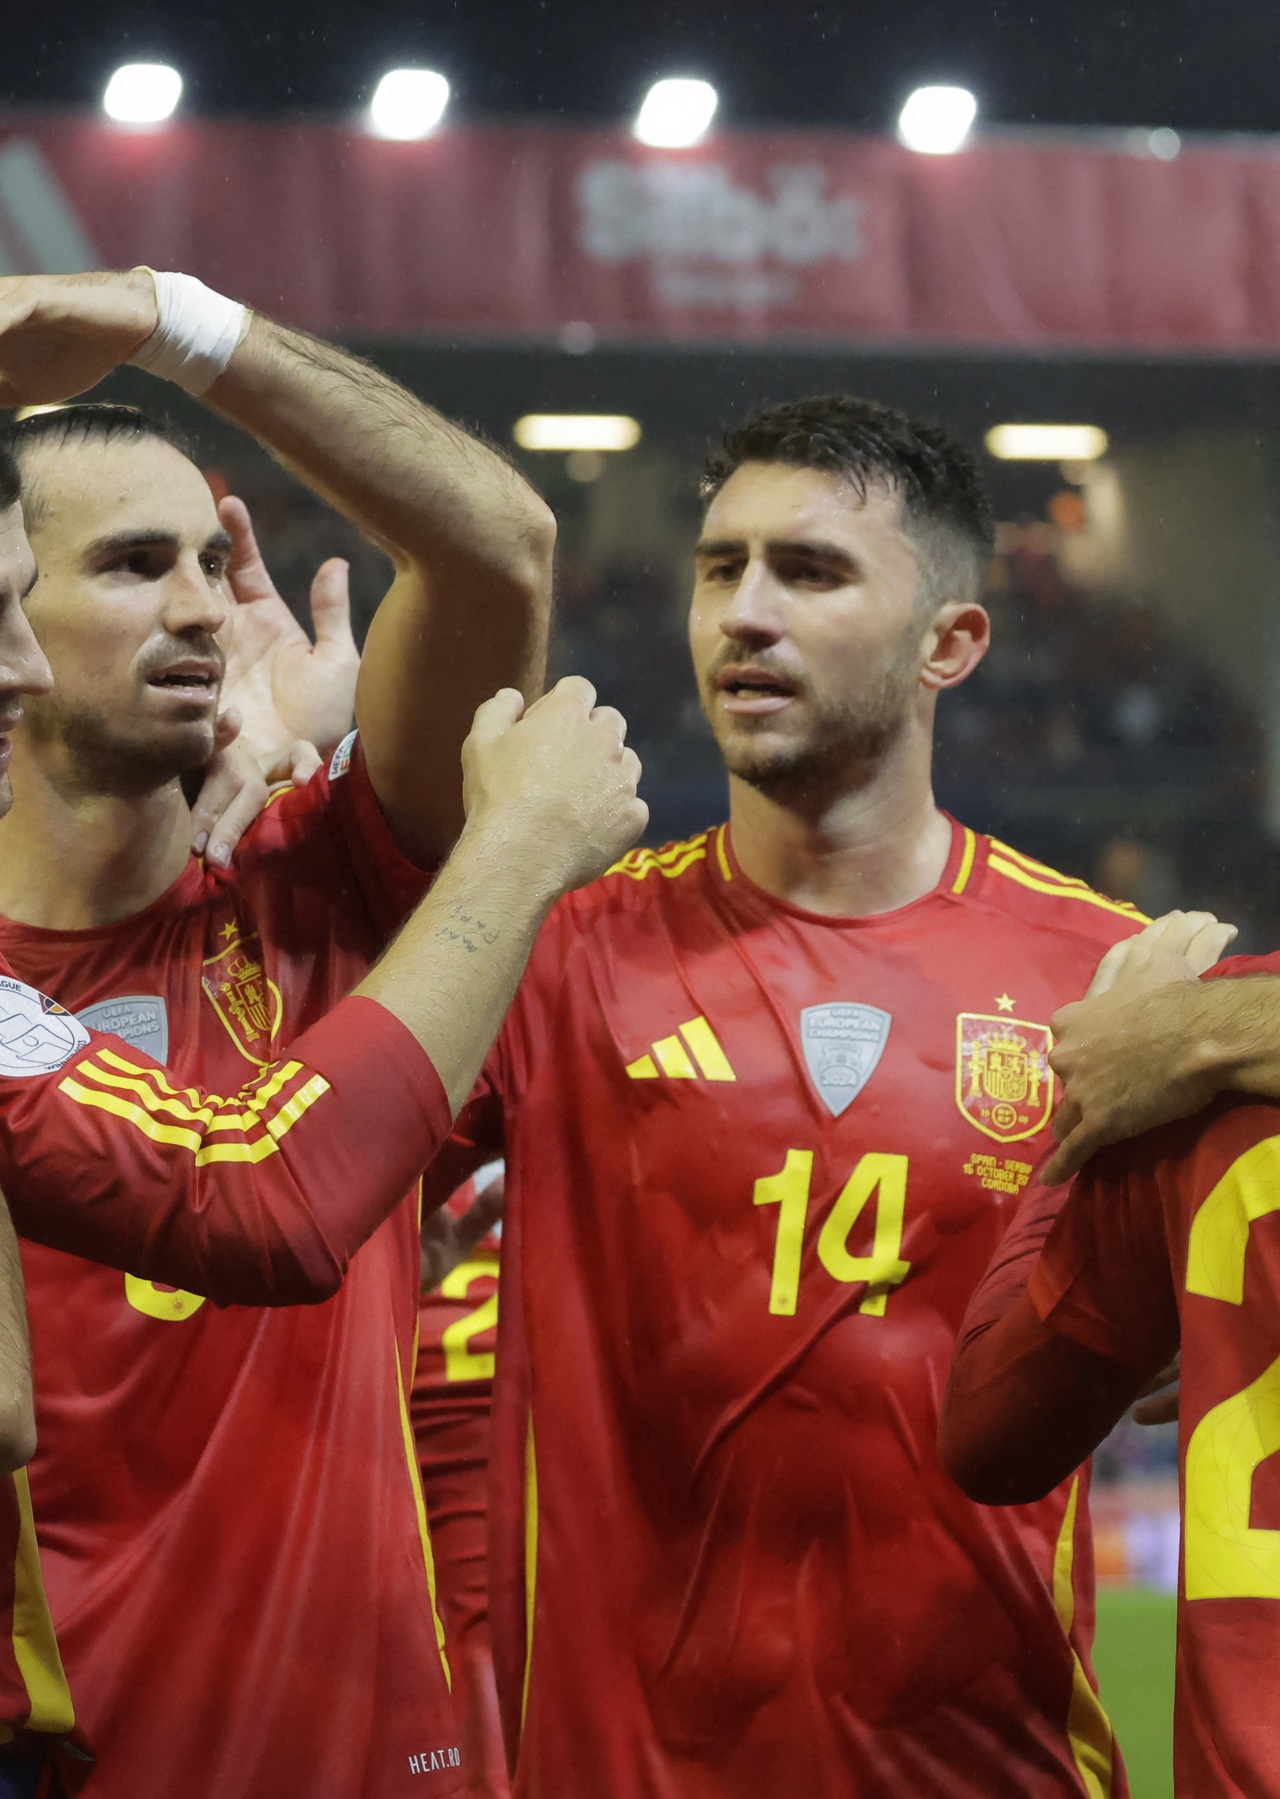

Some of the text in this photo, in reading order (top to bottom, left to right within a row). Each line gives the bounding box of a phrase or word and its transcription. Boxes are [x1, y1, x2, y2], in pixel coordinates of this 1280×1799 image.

[91, 1010, 158, 1032] UROPEAN
[102, 1005, 132, 1019] UEFA
[753, 1149, 911, 1317] 14
